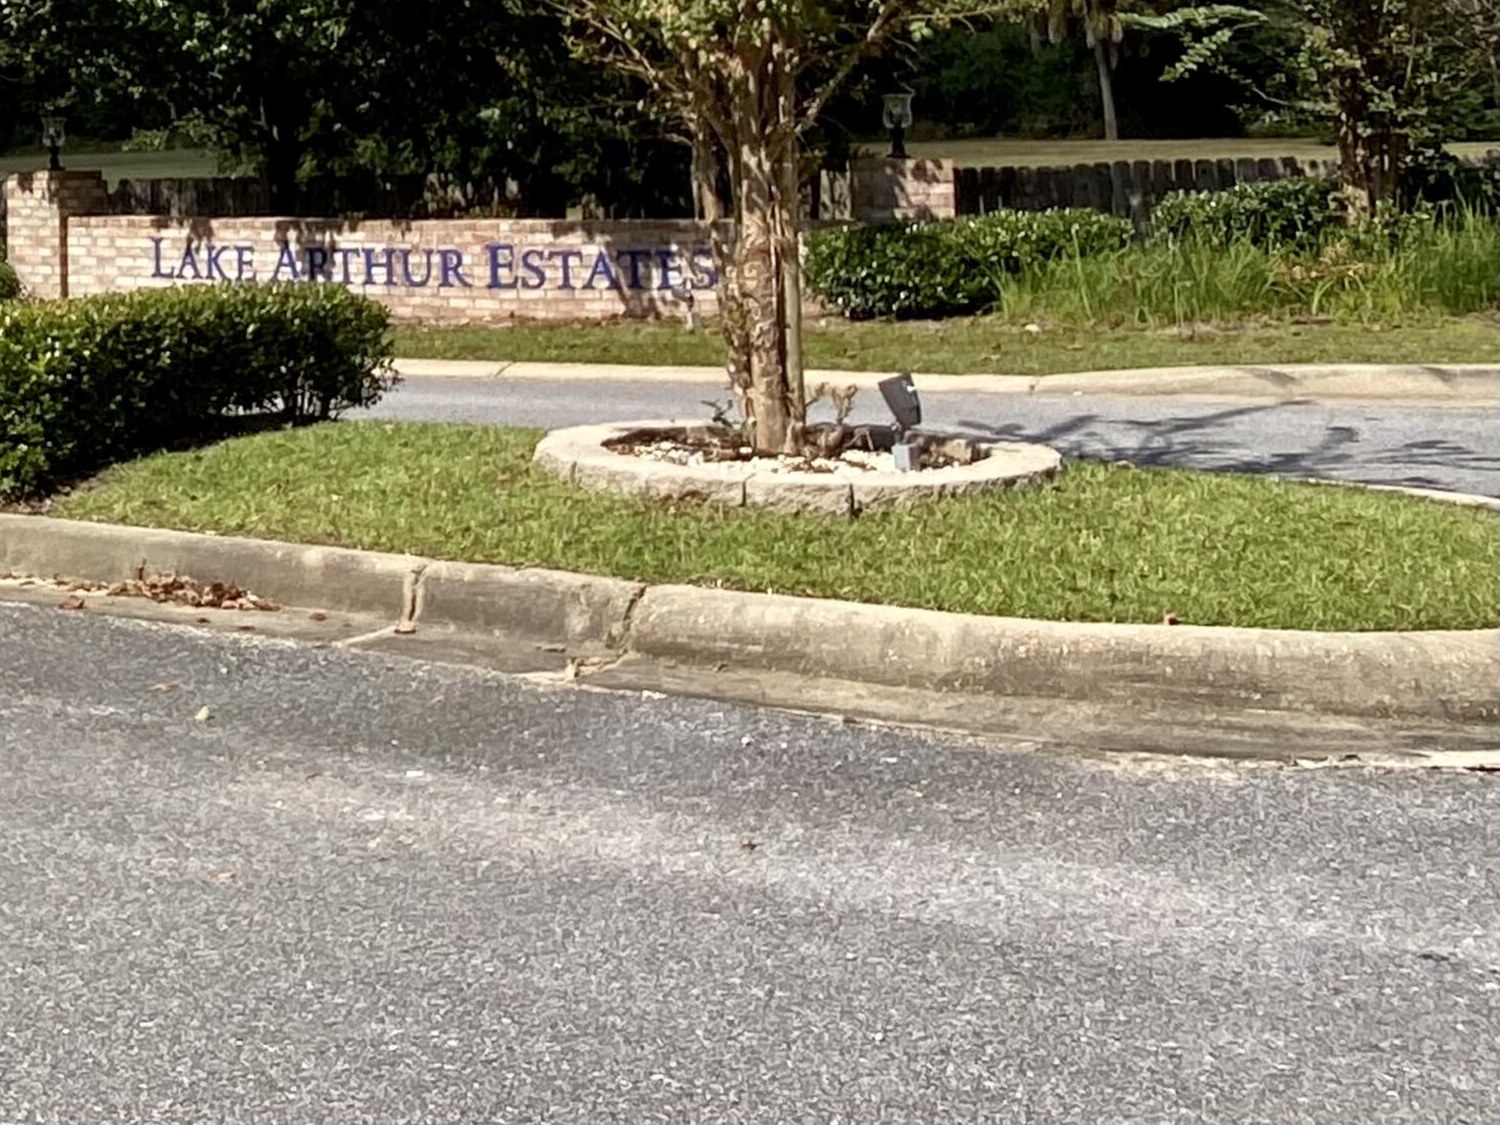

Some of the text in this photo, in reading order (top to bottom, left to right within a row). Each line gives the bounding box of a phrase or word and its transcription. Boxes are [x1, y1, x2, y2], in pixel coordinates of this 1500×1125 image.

[150, 236, 719, 290] LAKE ARTHUR ESTATES
